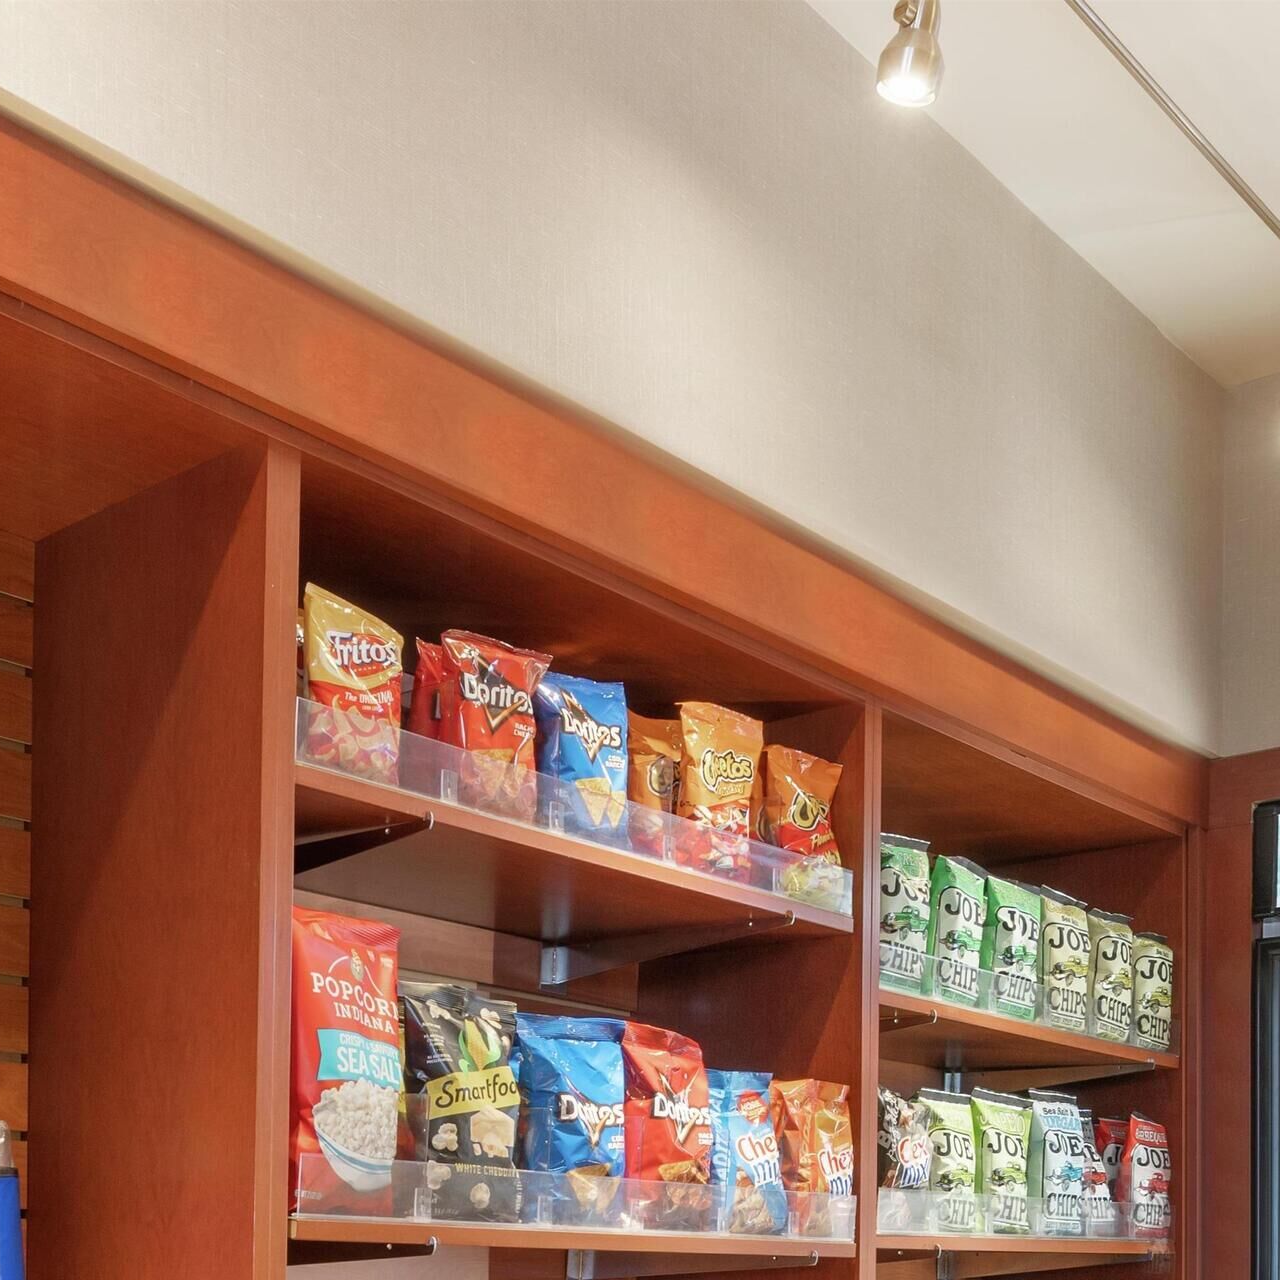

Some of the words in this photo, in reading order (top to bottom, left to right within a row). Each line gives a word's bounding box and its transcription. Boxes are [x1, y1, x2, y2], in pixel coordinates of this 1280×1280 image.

[325, 630, 398, 668] Fritos
[560, 706, 622, 750] Doritos
[310, 972, 400, 1021] POPCORN
[334, 1002, 396, 1035] INDIANA
[336, 1046, 370, 1076] SEA
[370, 1054, 402, 1086] SALT
[560, 1093, 625, 1126] Doritos
[653, 1090, 712, 1126] Doritos
[455, 1161, 482, 1176] WHITE
